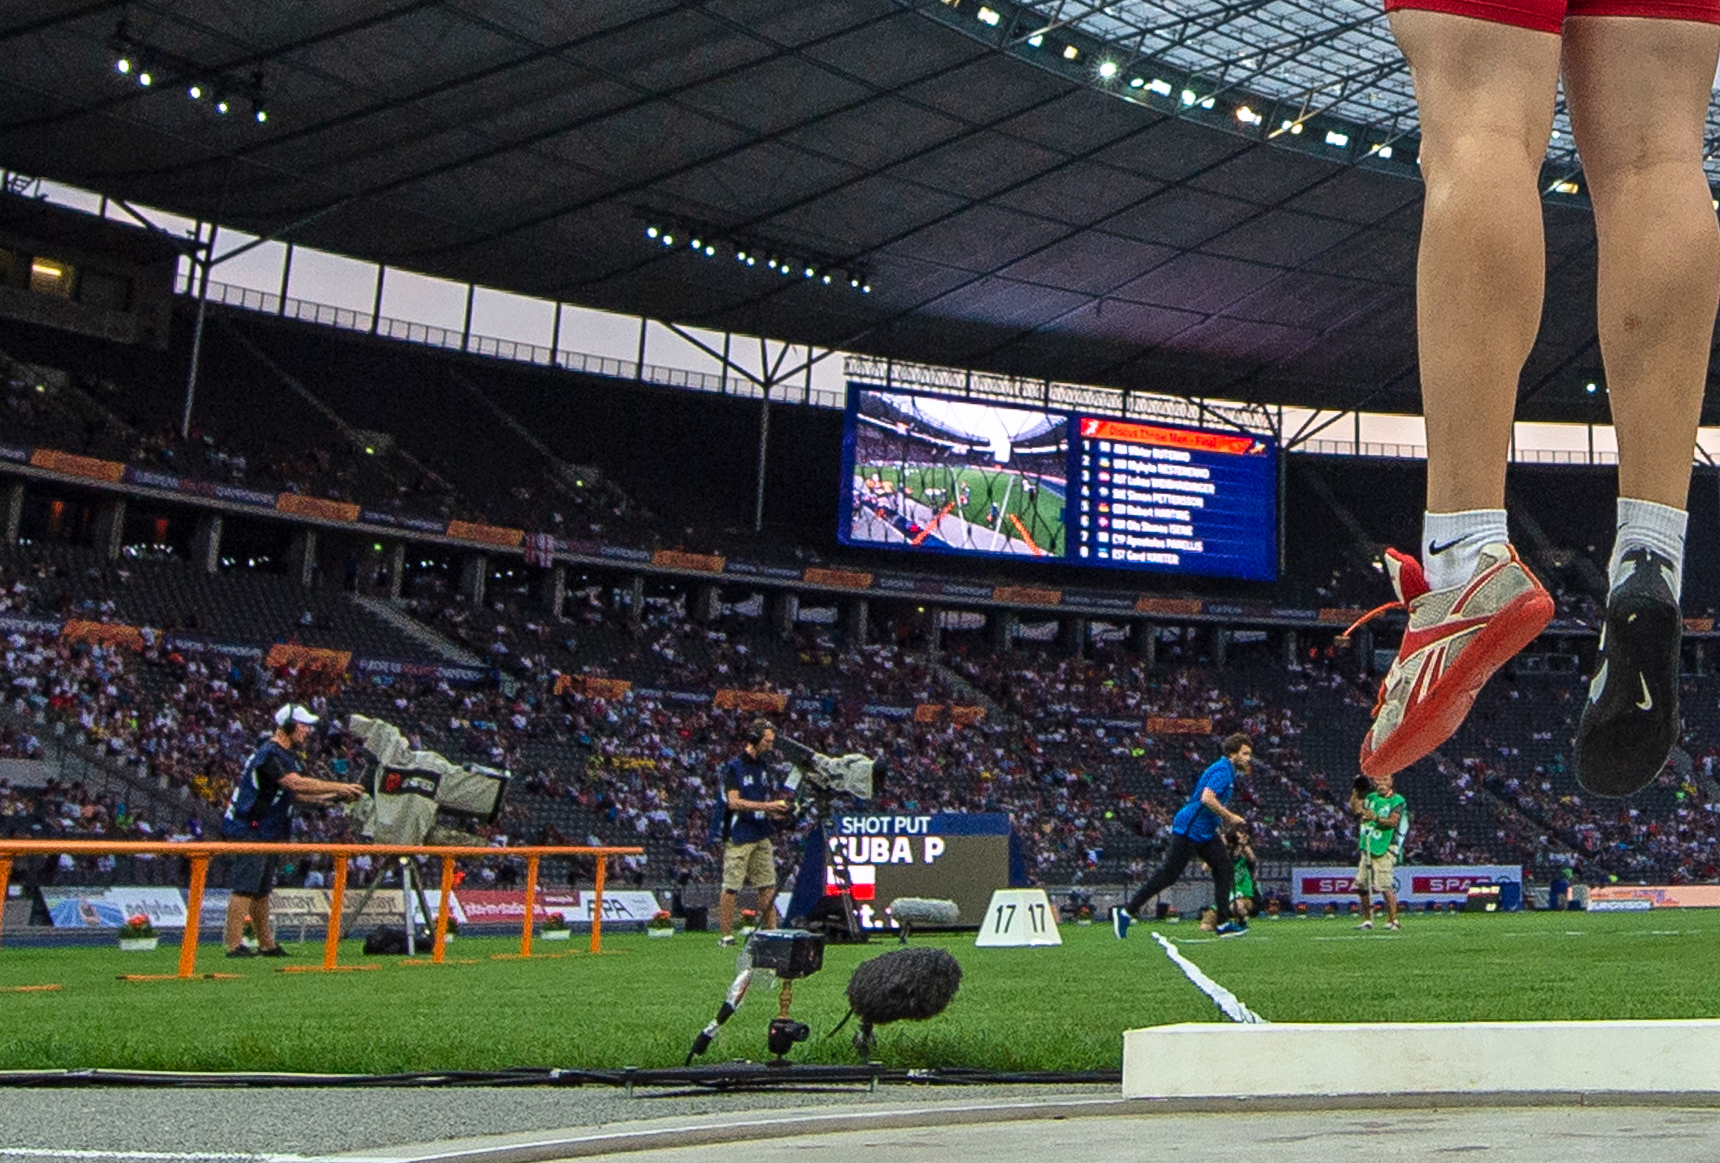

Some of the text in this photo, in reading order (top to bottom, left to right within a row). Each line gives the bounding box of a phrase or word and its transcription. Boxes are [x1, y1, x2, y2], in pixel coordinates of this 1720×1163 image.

[842, 817, 932, 834] SHOT PUT
[924, 836, 945, 864] P
[1430, 878, 1489, 891] SPA
[996, 903, 1017, 934] 17
[1028, 903, 1046, 933] 17
